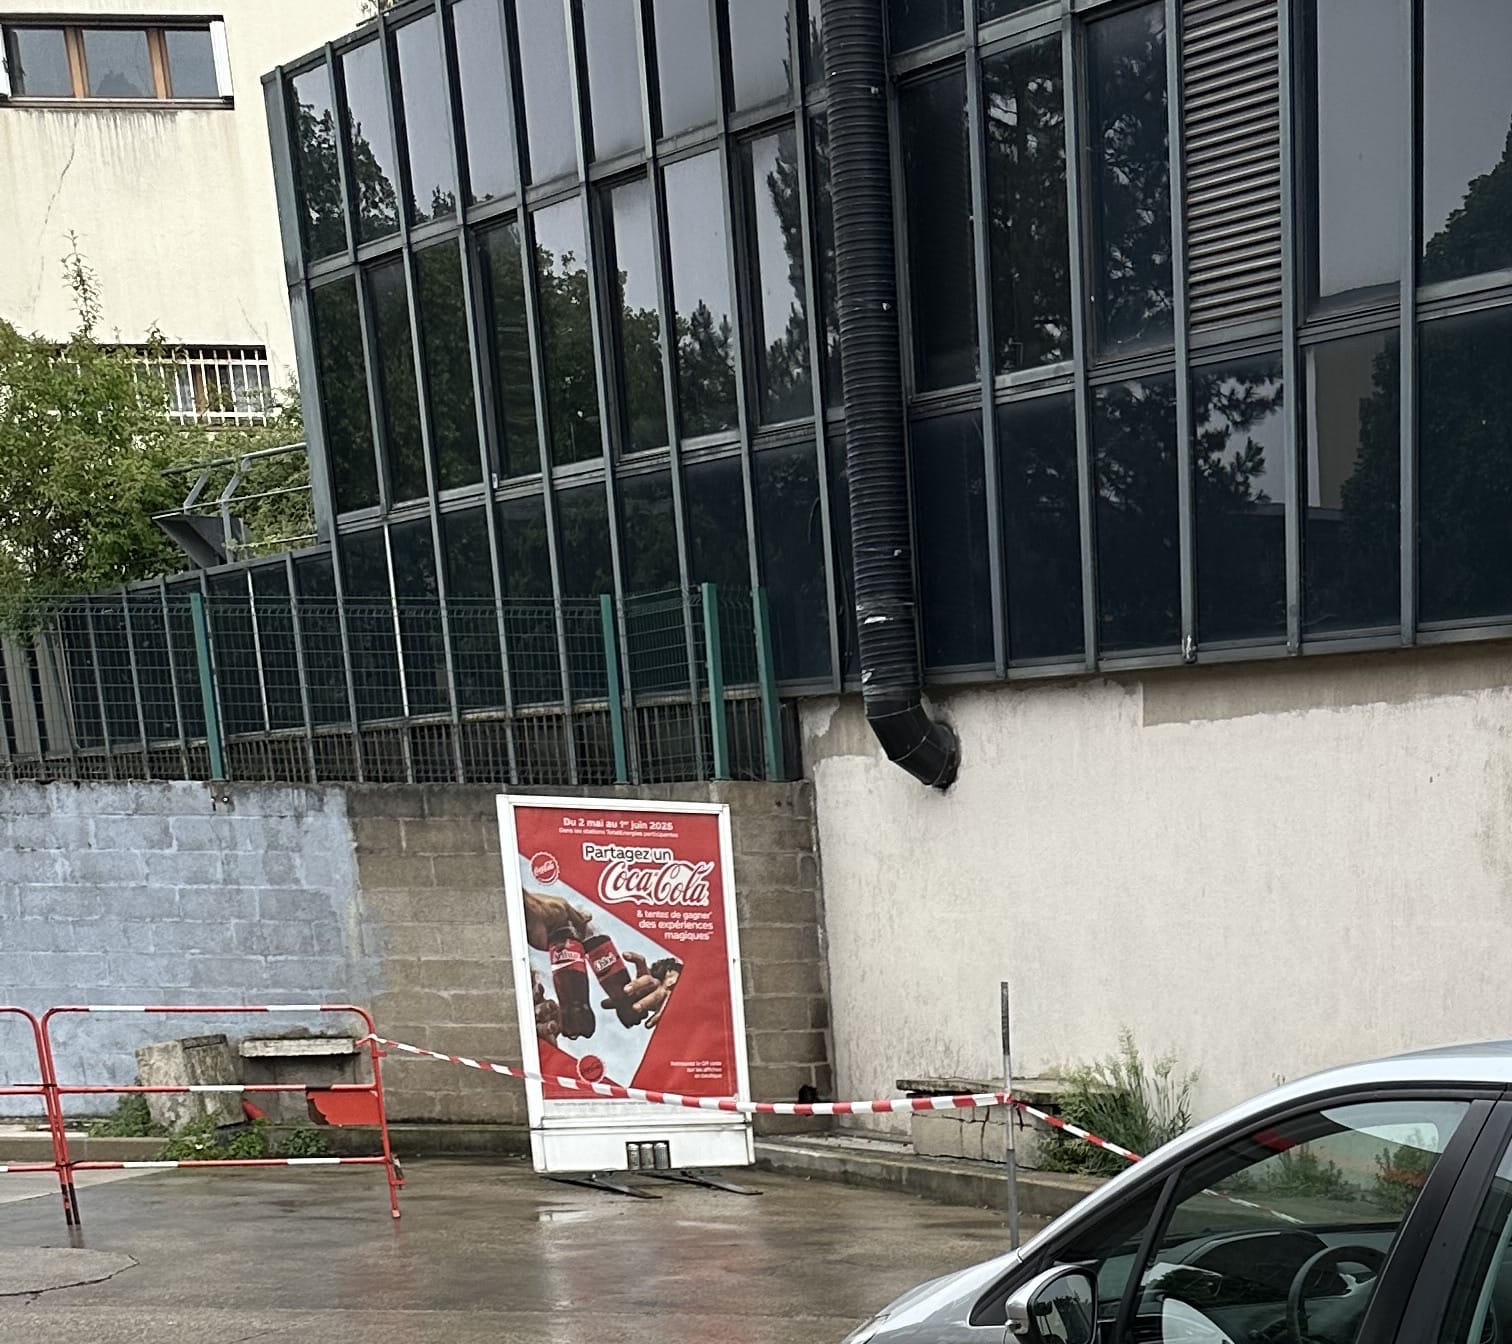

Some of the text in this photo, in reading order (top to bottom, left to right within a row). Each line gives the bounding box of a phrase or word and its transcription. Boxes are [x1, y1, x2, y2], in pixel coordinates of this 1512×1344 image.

[563, 817, 576, 827] Du
[579, 818, 585, 827] 2
[587, 818, 604, 828] mai
[606, 820, 617, 829] au
[631, 820, 648, 830] juin
[649, 821, 673, 831] 2025
[584, 845, 672, 861] Partagez un
[637, 909, 643, 918] &
[644, 910, 669, 918] tentez
[670, 910, 681, 919] de
[639, 919, 714, 930] des expériences
